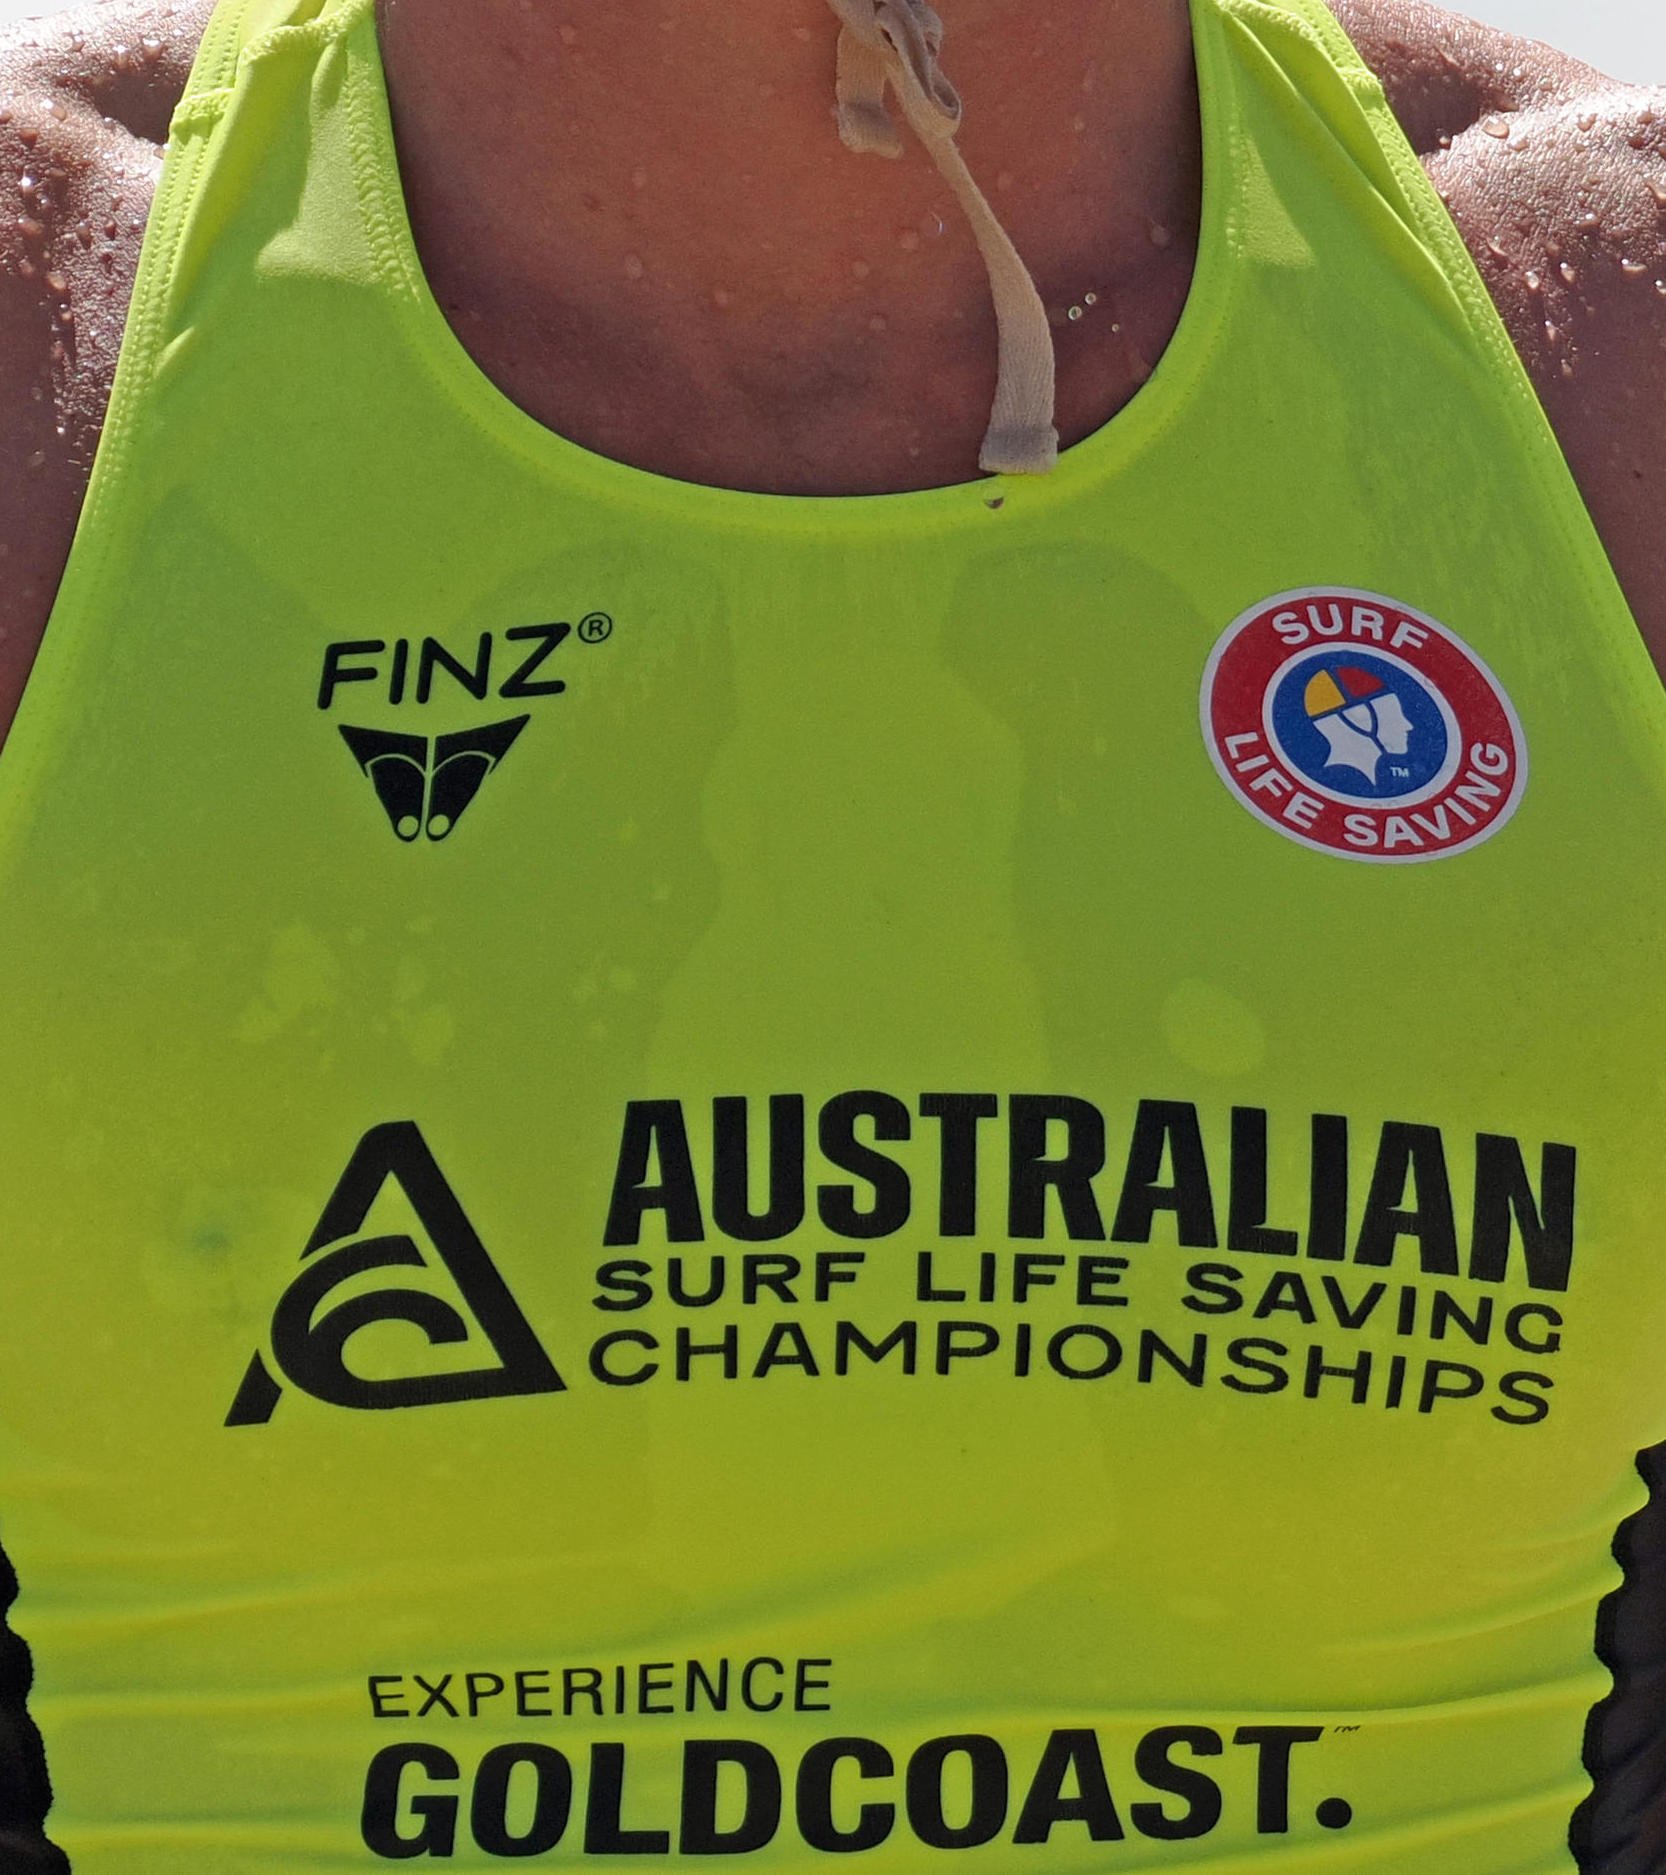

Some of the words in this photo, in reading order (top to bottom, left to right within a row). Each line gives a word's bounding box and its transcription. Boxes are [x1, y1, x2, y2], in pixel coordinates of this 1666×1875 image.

[1272, 602, 1429, 650] SURF
[1223, 730, 1326, 830] LIFE
[1342, 741, 1510, 849] SAVING
[601, 1089, 1577, 1293] AUSTRALIAN
[590, 1251, 867, 1313] SURF
[915, 1250, 1130, 1308] LIFE
[1179, 1261, 1565, 1356] SAVING
[586, 1319, 1555, 1427] CHAMPIONSHIPS
[367, 1655, 834, 1719] EXPERIENCE
